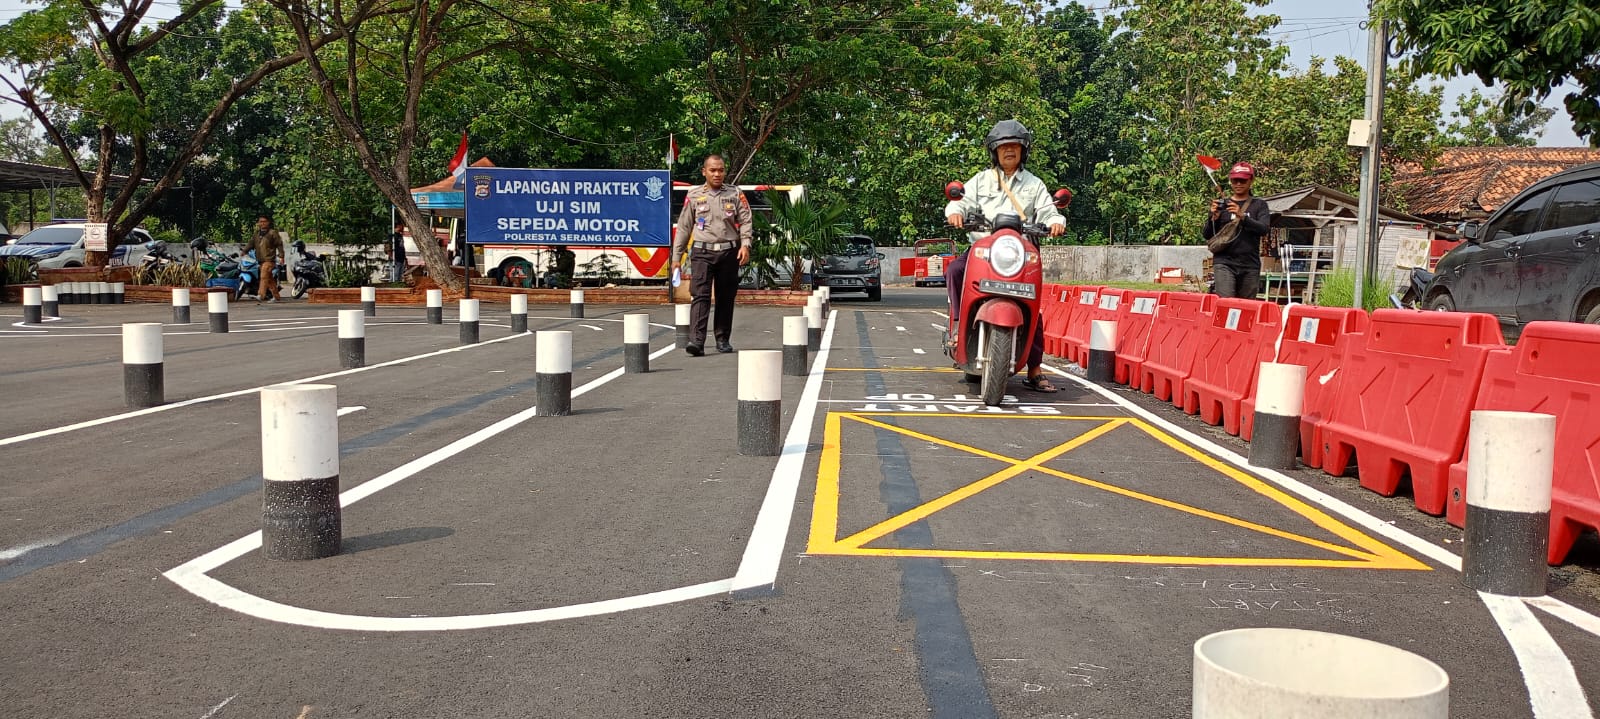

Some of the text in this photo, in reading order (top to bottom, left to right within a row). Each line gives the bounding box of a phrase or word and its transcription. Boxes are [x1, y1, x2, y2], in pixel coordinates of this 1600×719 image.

[495, 180, 640, 196] LAPANGAN PRAKTEK
[536, 200, 601, 214] UJI SIM
[497, 217, 640, 232] SEPEDA MOTOR
[504, 233, 633, 243] POLRESTA SERANG KOTA
[853, 403, 1061, 414] START
